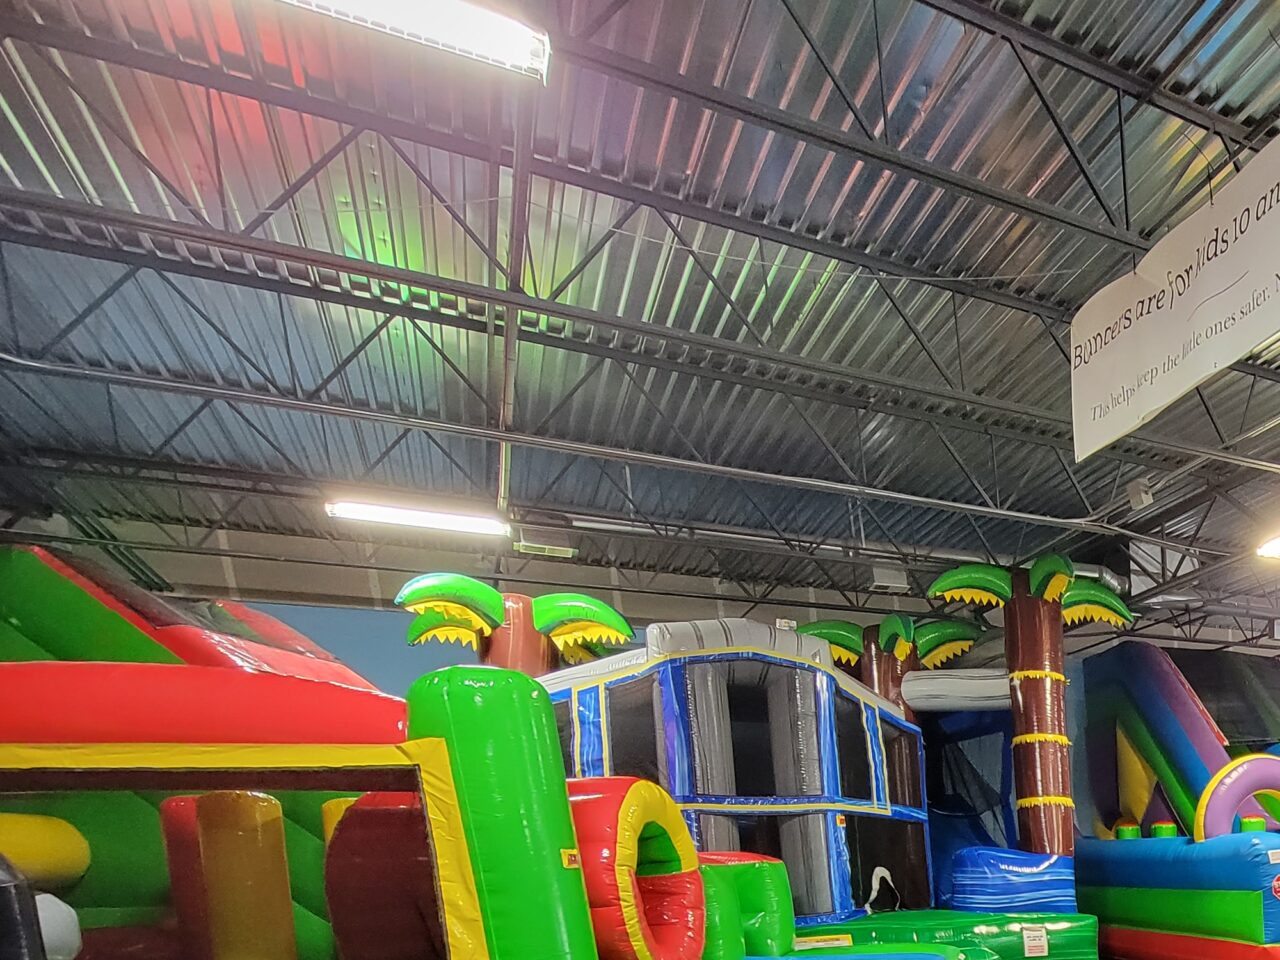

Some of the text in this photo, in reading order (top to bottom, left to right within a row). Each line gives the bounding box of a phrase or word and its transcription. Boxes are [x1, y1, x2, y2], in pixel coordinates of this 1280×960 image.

[1073, 308, 1132, 371] Bouncers
[1135, 288, 1166, 320] are
[1167, 264, 1193, 310] for
[1232, 207, 1251, 244] 10
[1110, 385, 1136, 407] helps
[1162, 354, 1179, 374] the
[1205, 311, 1236, 339] ones
[1239, 287, 1271, 320] safer.
